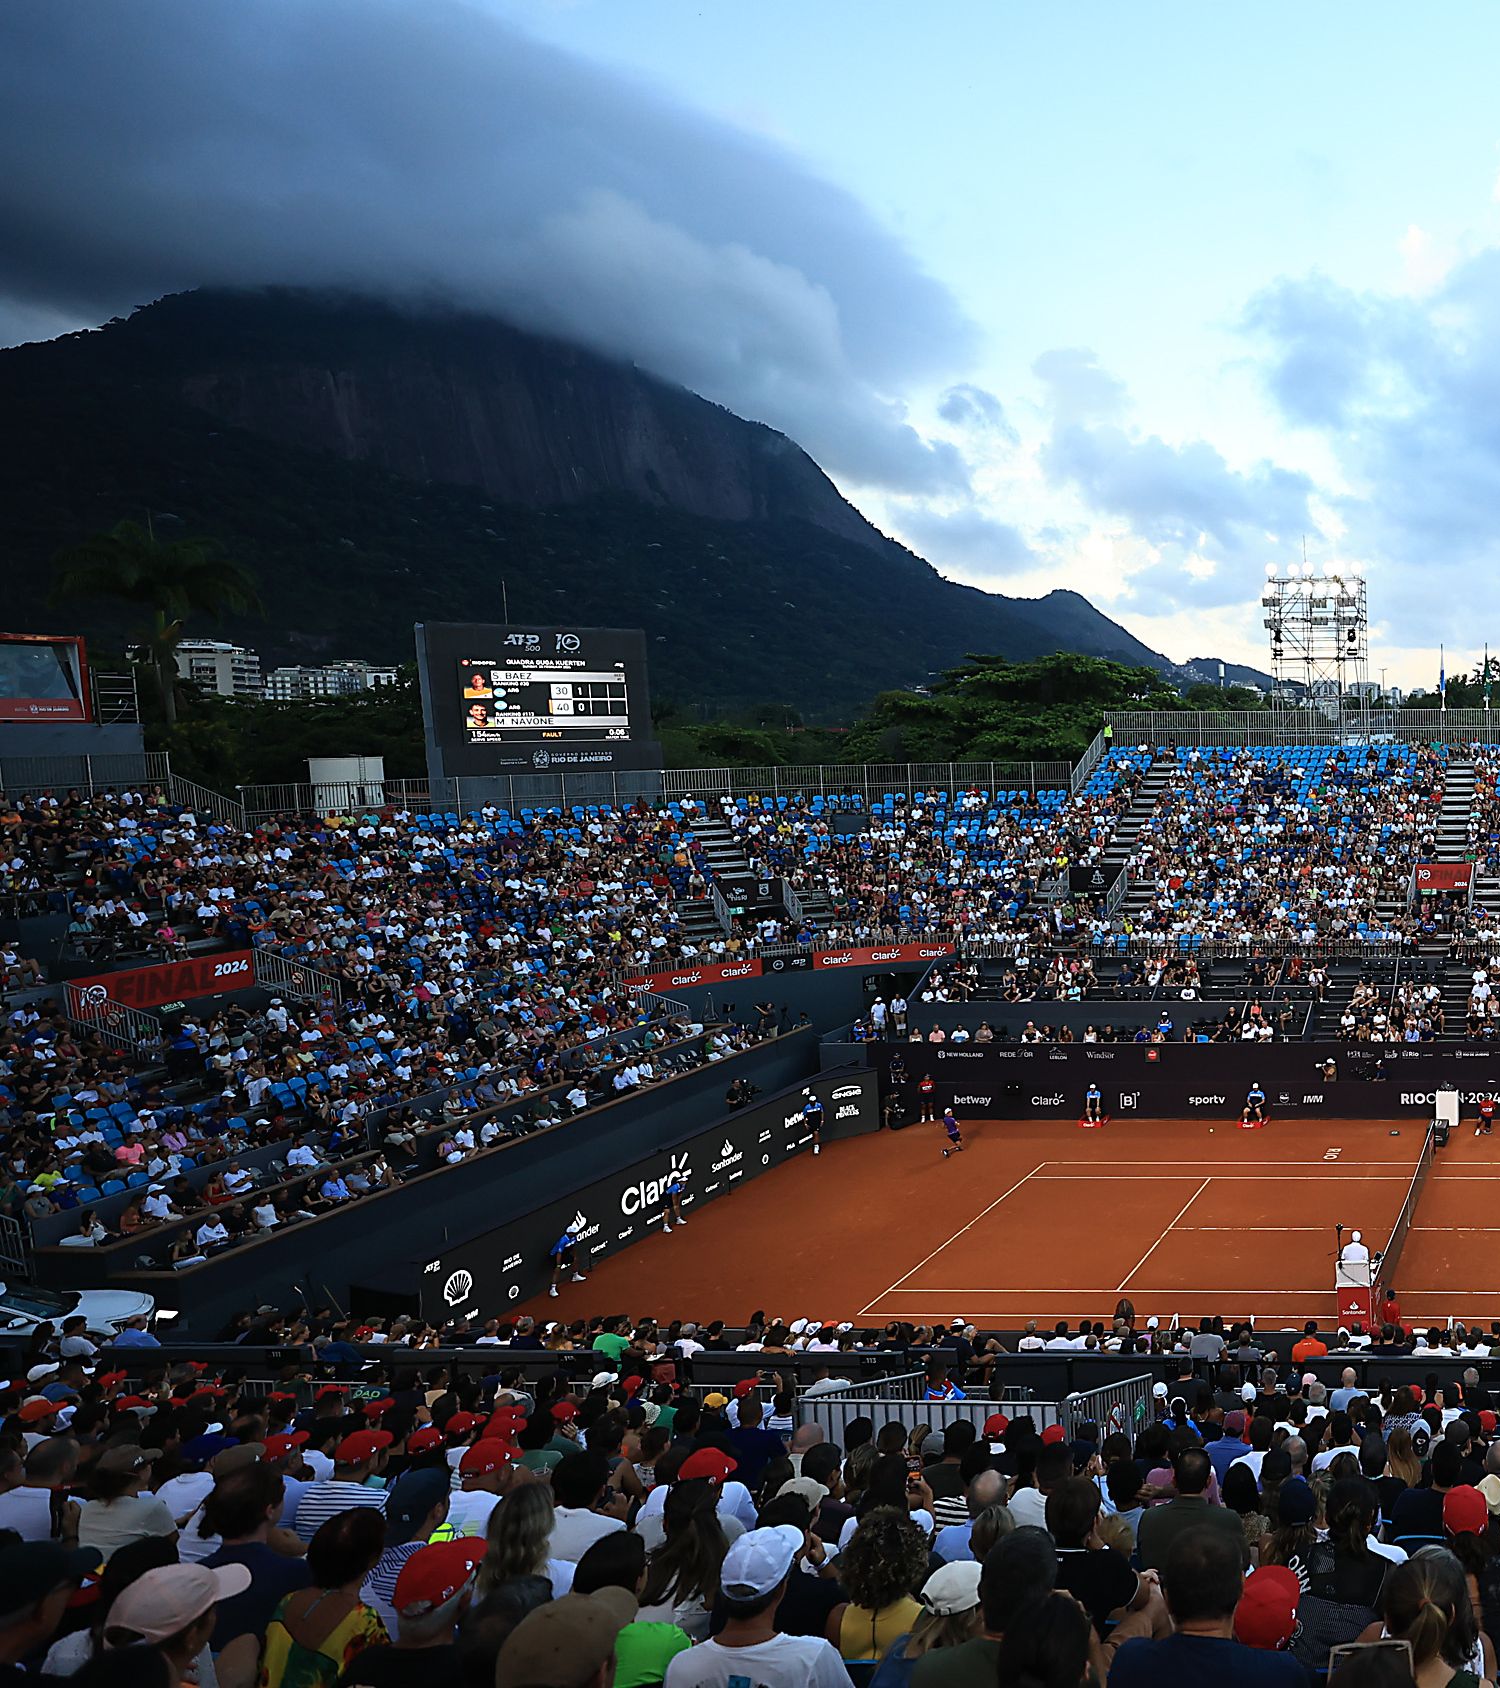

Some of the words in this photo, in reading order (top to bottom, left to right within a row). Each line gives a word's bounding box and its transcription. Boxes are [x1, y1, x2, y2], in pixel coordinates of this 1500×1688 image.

[503, 633, 541, 646] ATP
[505, 672, 533, 680] BAEZ
[555, 686, 568, 695] 30
[556, 703, 569, 712] 40
[578, 703, 585, 711] 0
[511, 717, 554, 725] NAVONE
[551, 756, 563, 764] RIO
[564, 755, 578, 763] DE
[579, 755, 613, 763] JANEIRO
[871, 949, 901, 961] Claro
[919, 946, 947, 957] Claro
[822, 953, 853, 966] Claro
[721, 963, 753, 977] Claro
[114, 962, 217, 1003] FINAL
[214, 959, 249, 977] 2024
[671, 971, 701, 985] Claro
[1086, 1050, 1115, 1059] Windsor
[953, 1094, 991, 1106] betway
[1031, 1093, 1065, 1106] Claro
[1188, 1095, 1226, 1105] sportv
[1302, 1095, 1324, 1104] IMM
[1323, 1147, 1342, 1160] RIO
[711, 1151, 744, 1173] Santander
[1288, 1554, 1312, 1594] OHN
